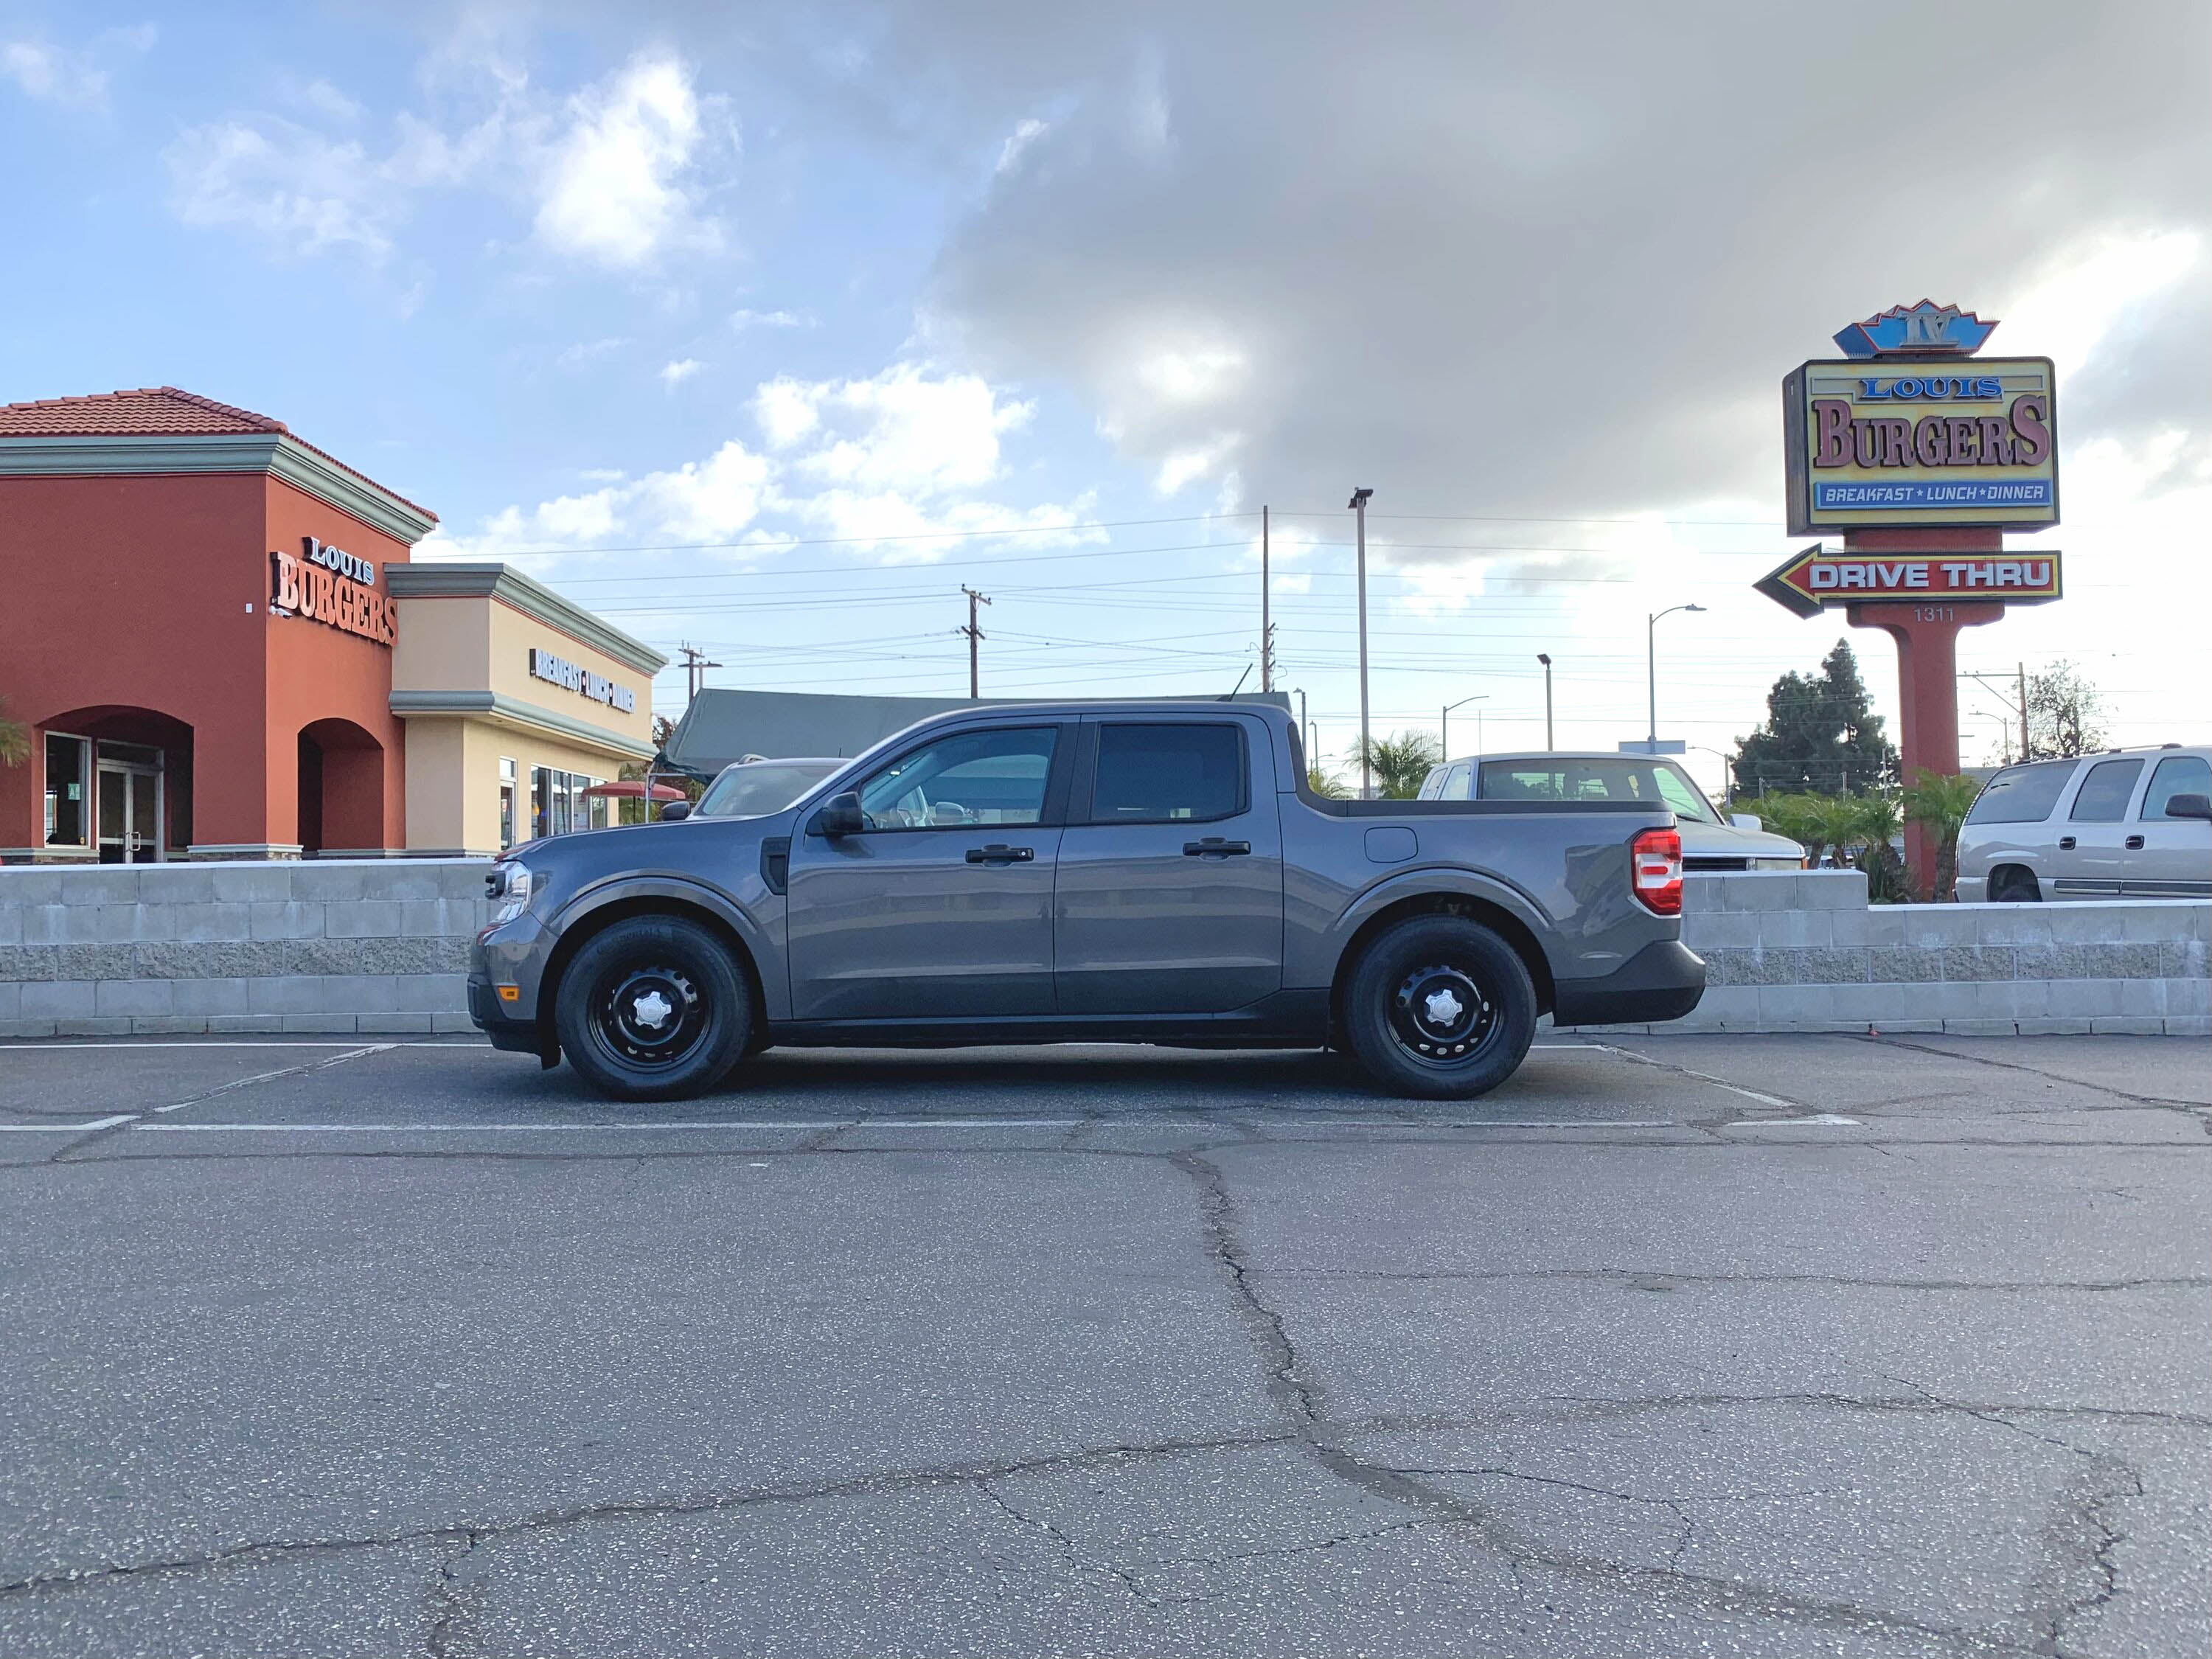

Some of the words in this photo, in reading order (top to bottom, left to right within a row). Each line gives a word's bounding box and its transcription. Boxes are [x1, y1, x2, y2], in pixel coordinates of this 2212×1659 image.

[1899, 312, 1960, 347] IV
[1860, 377, 2003, 399] LOUIS
[1812, 394, 2051, 468] BURGERS
[1825, 487, 1914, 502] BREAKFAST
[1926, 486, 1977, 501] LUNCH
[1986, 485, 2045, 500] DINNER
[308, 537, 375, 586] LOUIS
[1809, 563, 1930, 588] DRIVE
[1940, 562, 2051, 588] THRU
[276, 551, 399, 647] BURGERS
[1914, 606, 1955, 622] 1311
[534, 648, 582, 692] BREAKFAST
